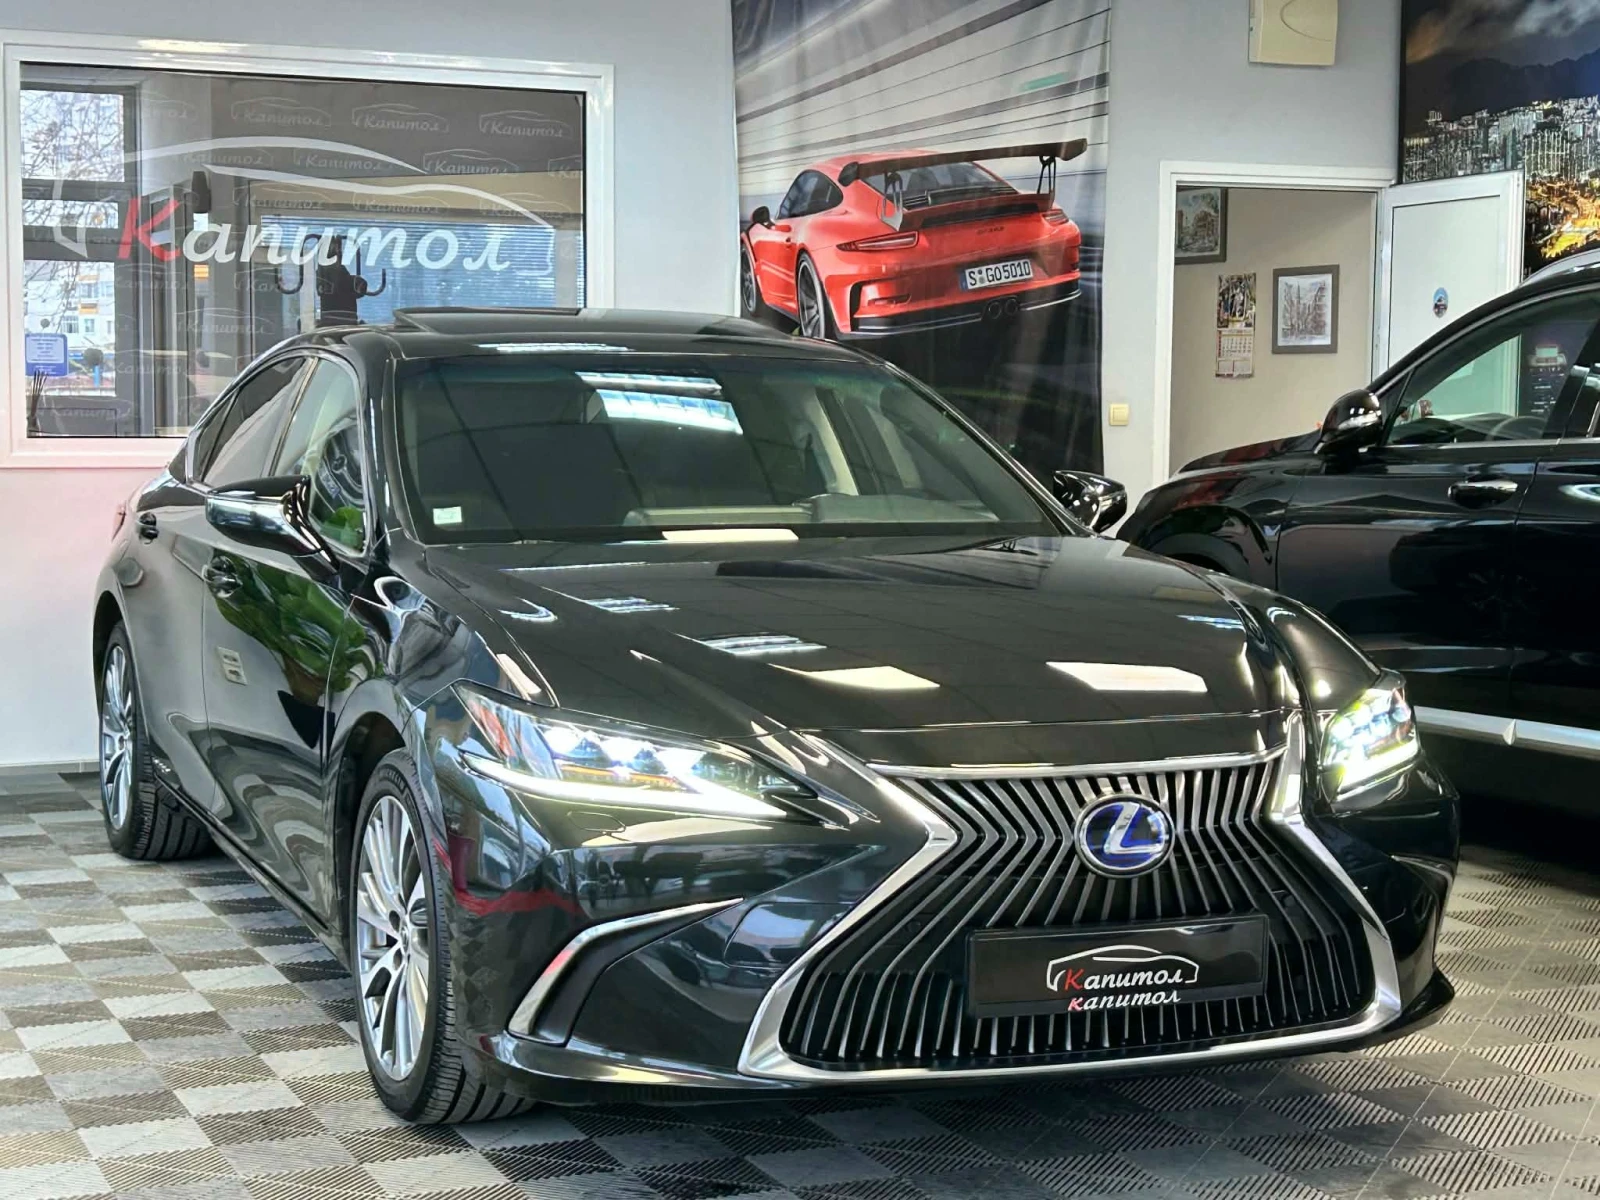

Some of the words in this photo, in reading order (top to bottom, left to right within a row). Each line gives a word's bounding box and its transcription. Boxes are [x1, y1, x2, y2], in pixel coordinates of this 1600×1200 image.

[118, 195, 512, 272] Капитол
[968, 270, 977, 286] S
[1064, 967, 1183, 990] Капитол
